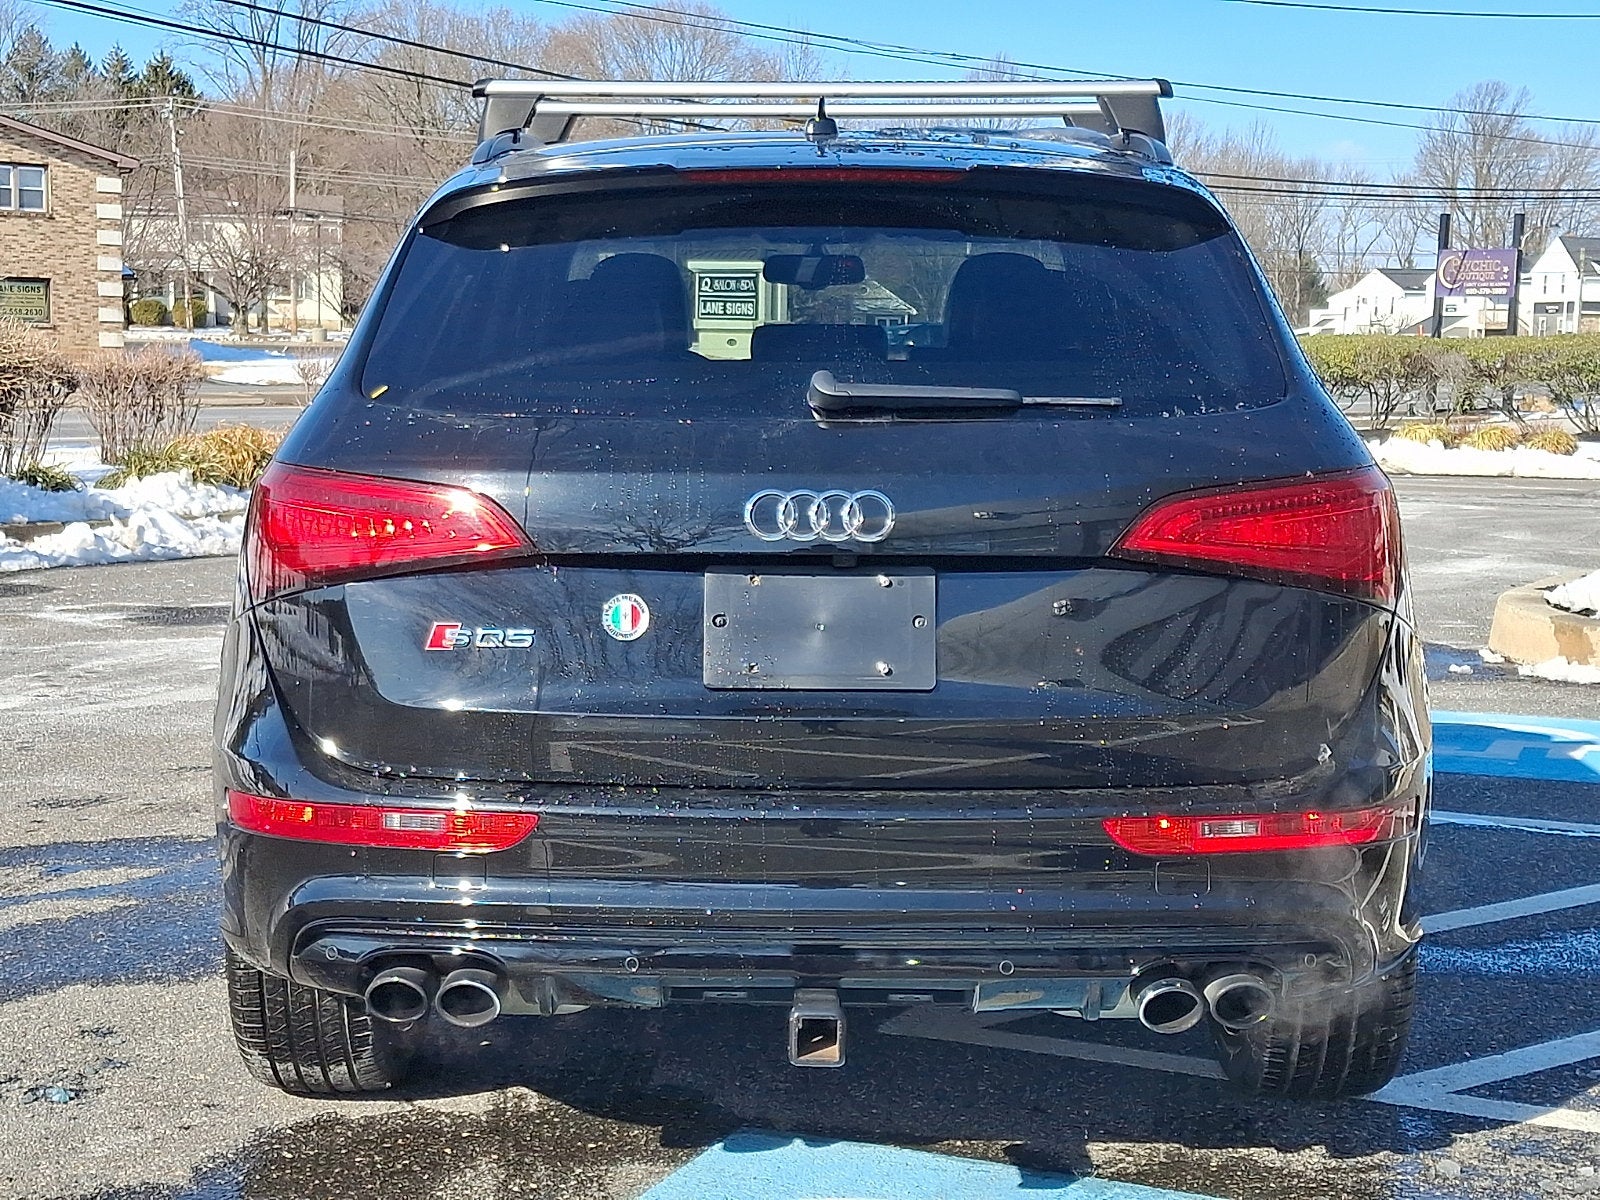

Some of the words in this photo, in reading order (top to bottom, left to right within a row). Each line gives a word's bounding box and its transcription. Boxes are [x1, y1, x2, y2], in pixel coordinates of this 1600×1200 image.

[1453, 258, 1501, 273] PSYCHIC
[17, 285, 41, 293] SIGNS
[701, 277, 714, 292] Q
[740, 279, 756, 291] SPA
[701, 302, 725, 315] LANE
[725, 302, 754, 316] SIGNS
[440, 625, 536, 649] SQ5
